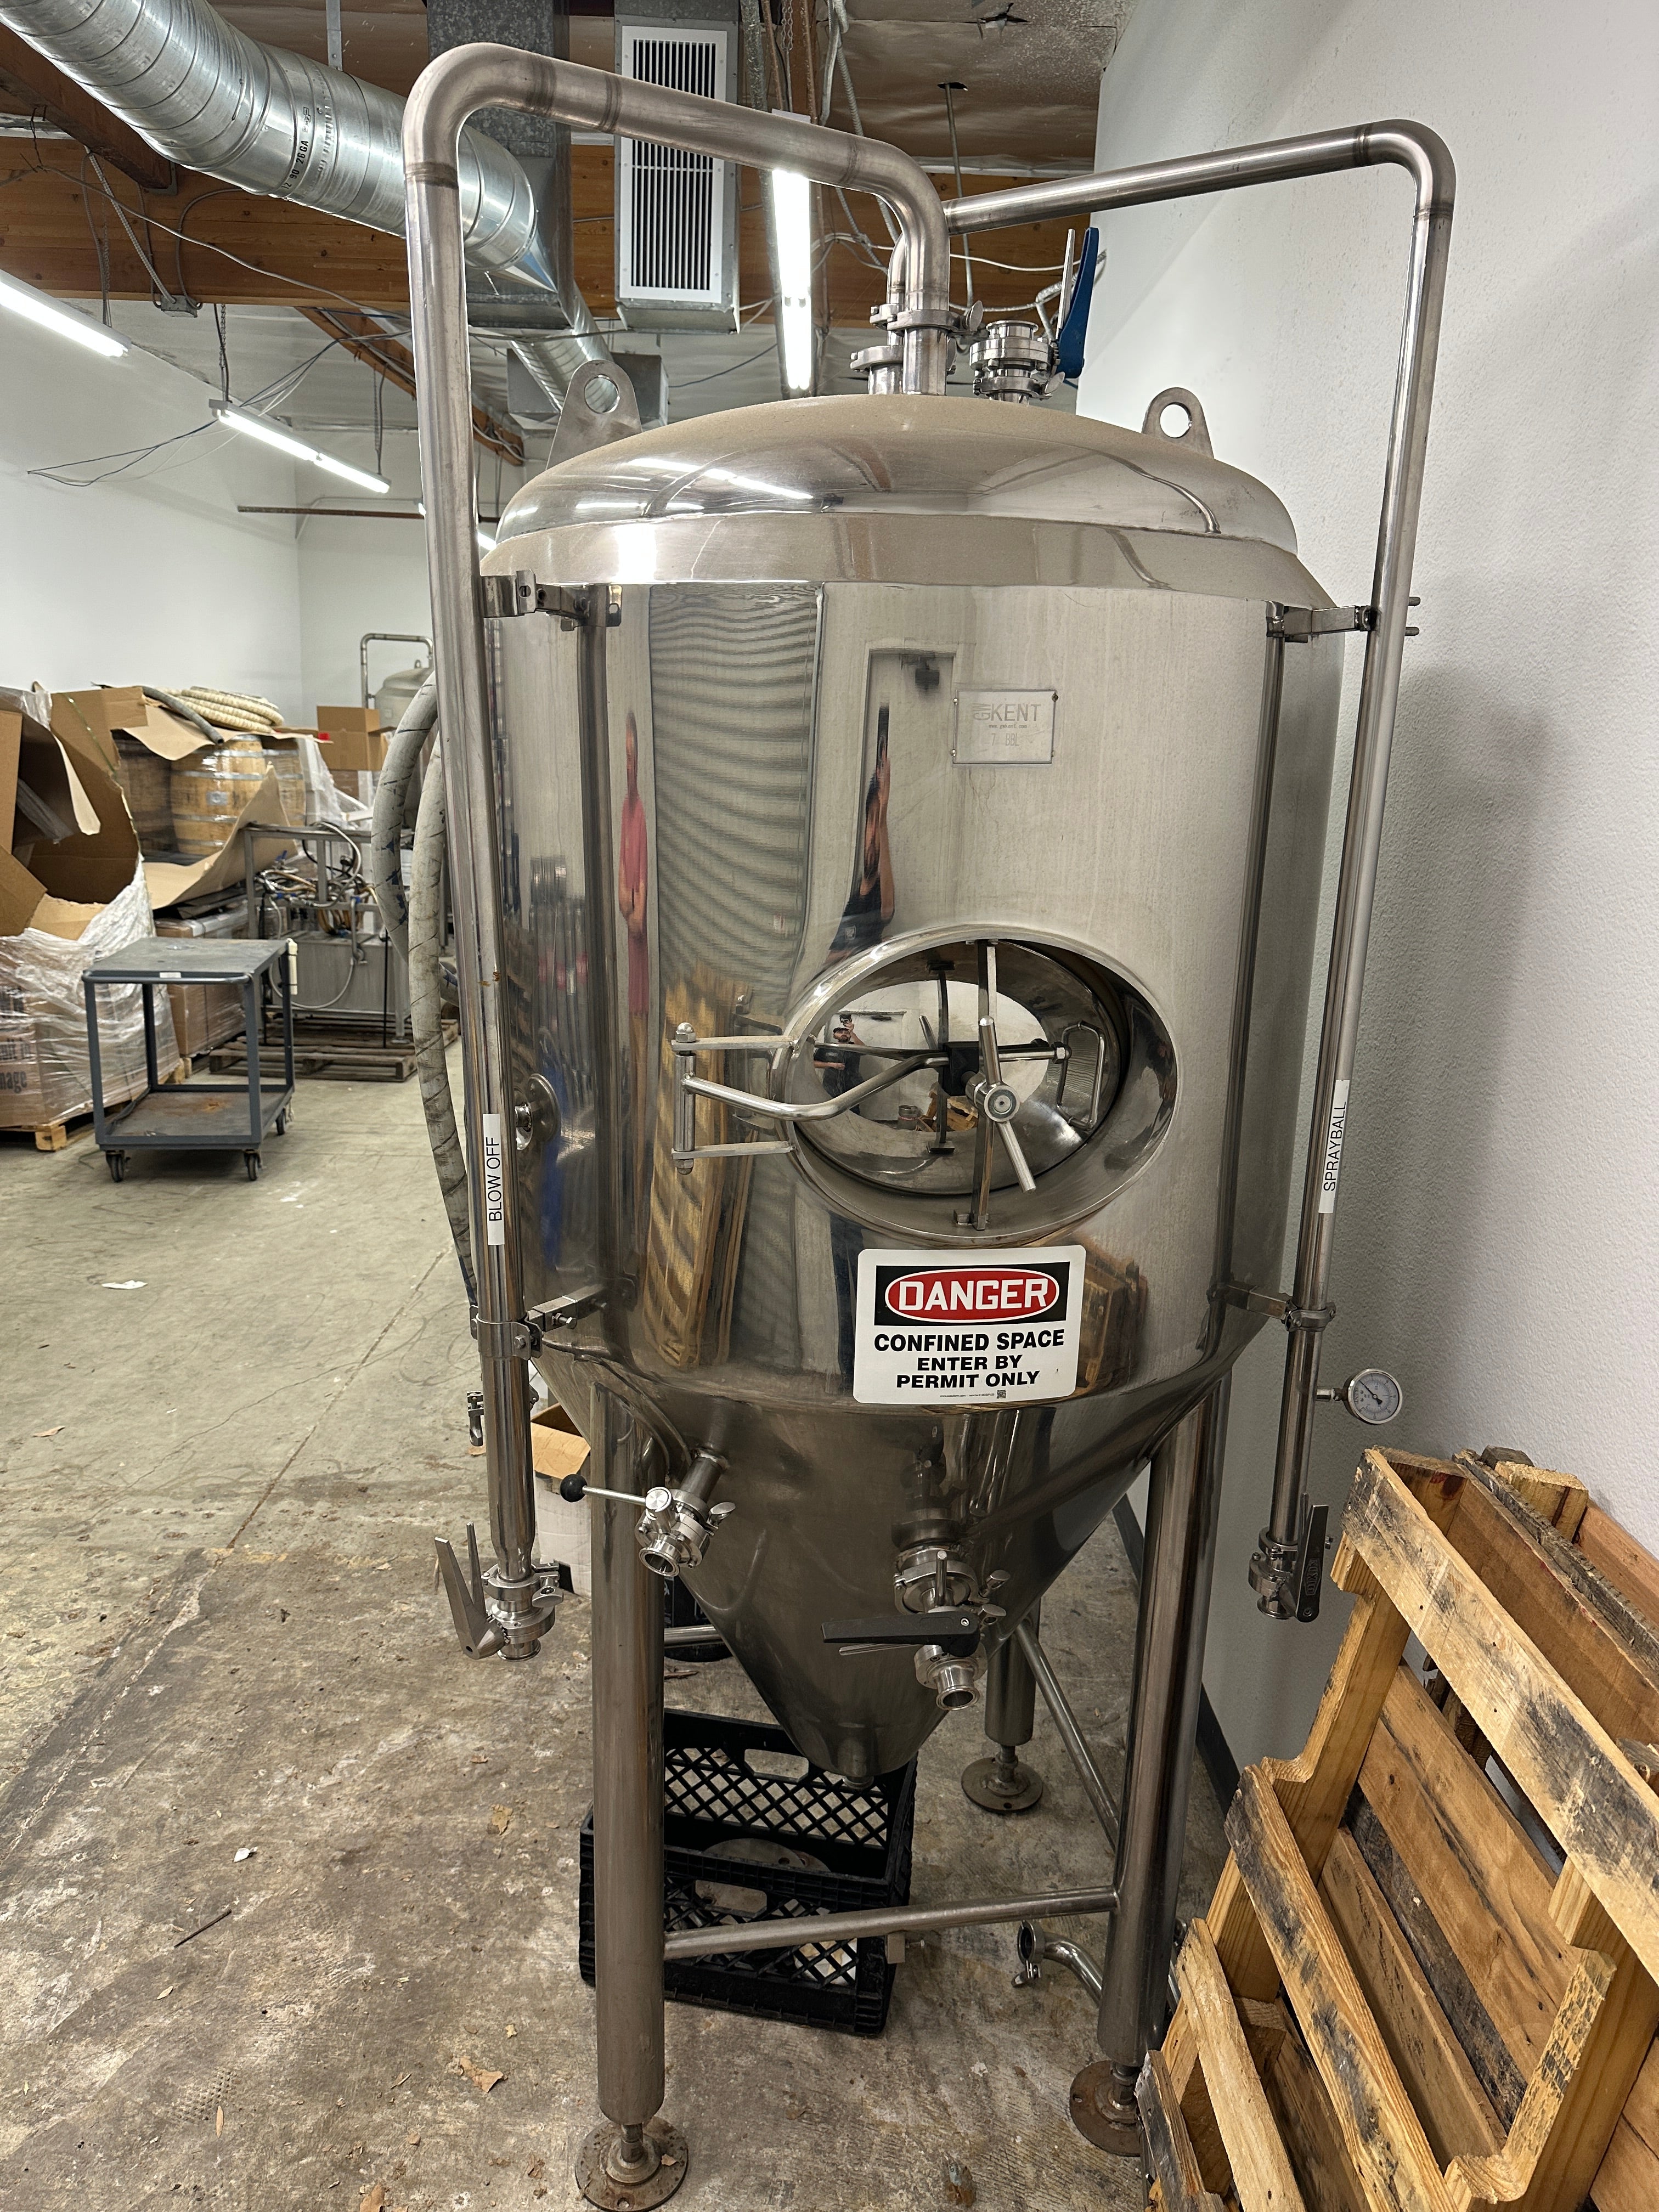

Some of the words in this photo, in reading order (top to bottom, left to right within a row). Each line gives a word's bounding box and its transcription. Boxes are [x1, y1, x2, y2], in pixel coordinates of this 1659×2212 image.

[290, 169, 300, 179] 90
[991, 703, 1041, 721] KENT
[991, 733, 996, 746] 7
[1005, 733, 1019, 746] BBL
[486, 1137, 500, 1169] OFF
[1323, 1102, 1346, 1191] SPRAYBALL
[487, 1175, 502, 1221] BLOW
[899, 1278, 1048, 1311] DANGER
[874, 1334, 989, 1352] CONFINED
[996, 1329, 1064, 1350] SPACE
[917, 1356, 988, 1371] ENTER
[995, 1355, 1023, 1369] BY
[896, 1374, 979, 1389] PERMIT
[985, 1370, 1040, 1386] ONLY
[1307, 1559, 1318, 1594] DIXON
